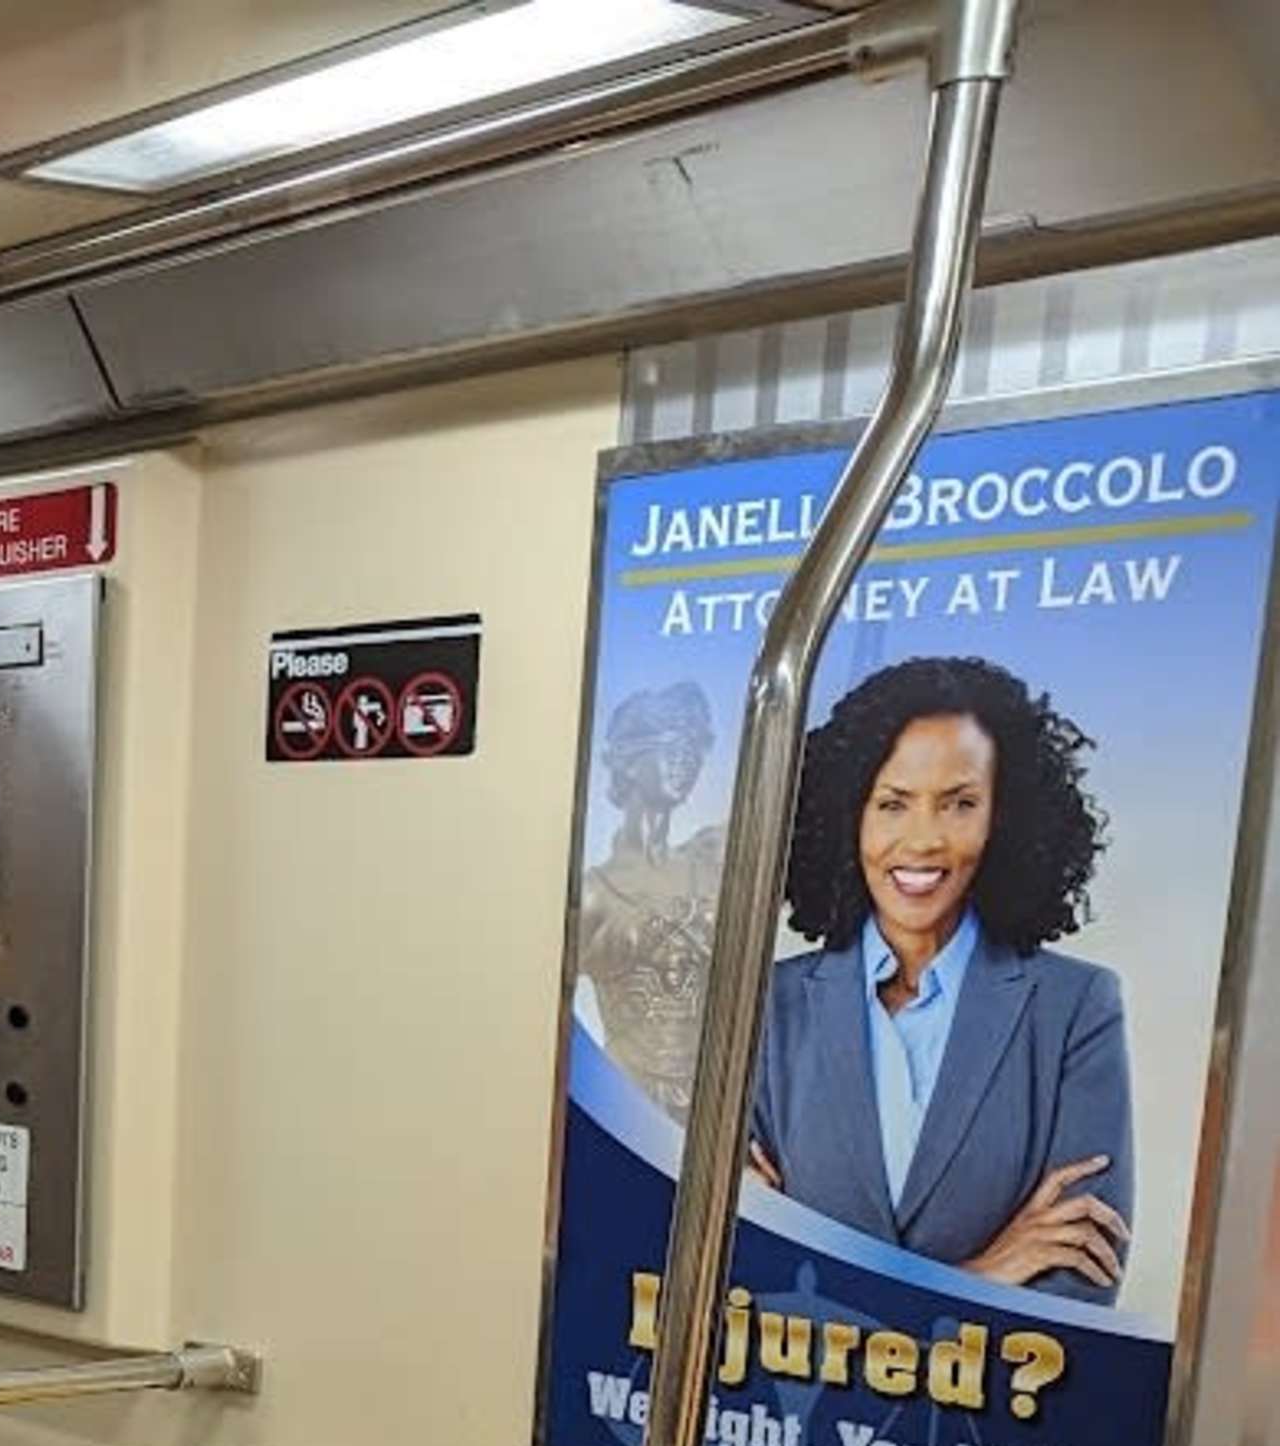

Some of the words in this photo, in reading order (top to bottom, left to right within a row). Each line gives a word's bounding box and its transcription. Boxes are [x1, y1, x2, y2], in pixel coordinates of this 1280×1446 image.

[630, 495, 816, 556] JANELL
[884, 445, 1238, 532] BROCCOLO
[946, 569, 1020, 615] AT
[1038, 554, 1183, 612] LAW
[272, 650, 349, 680] Please
[628, 1271, 1065, 1421] Ijured?
